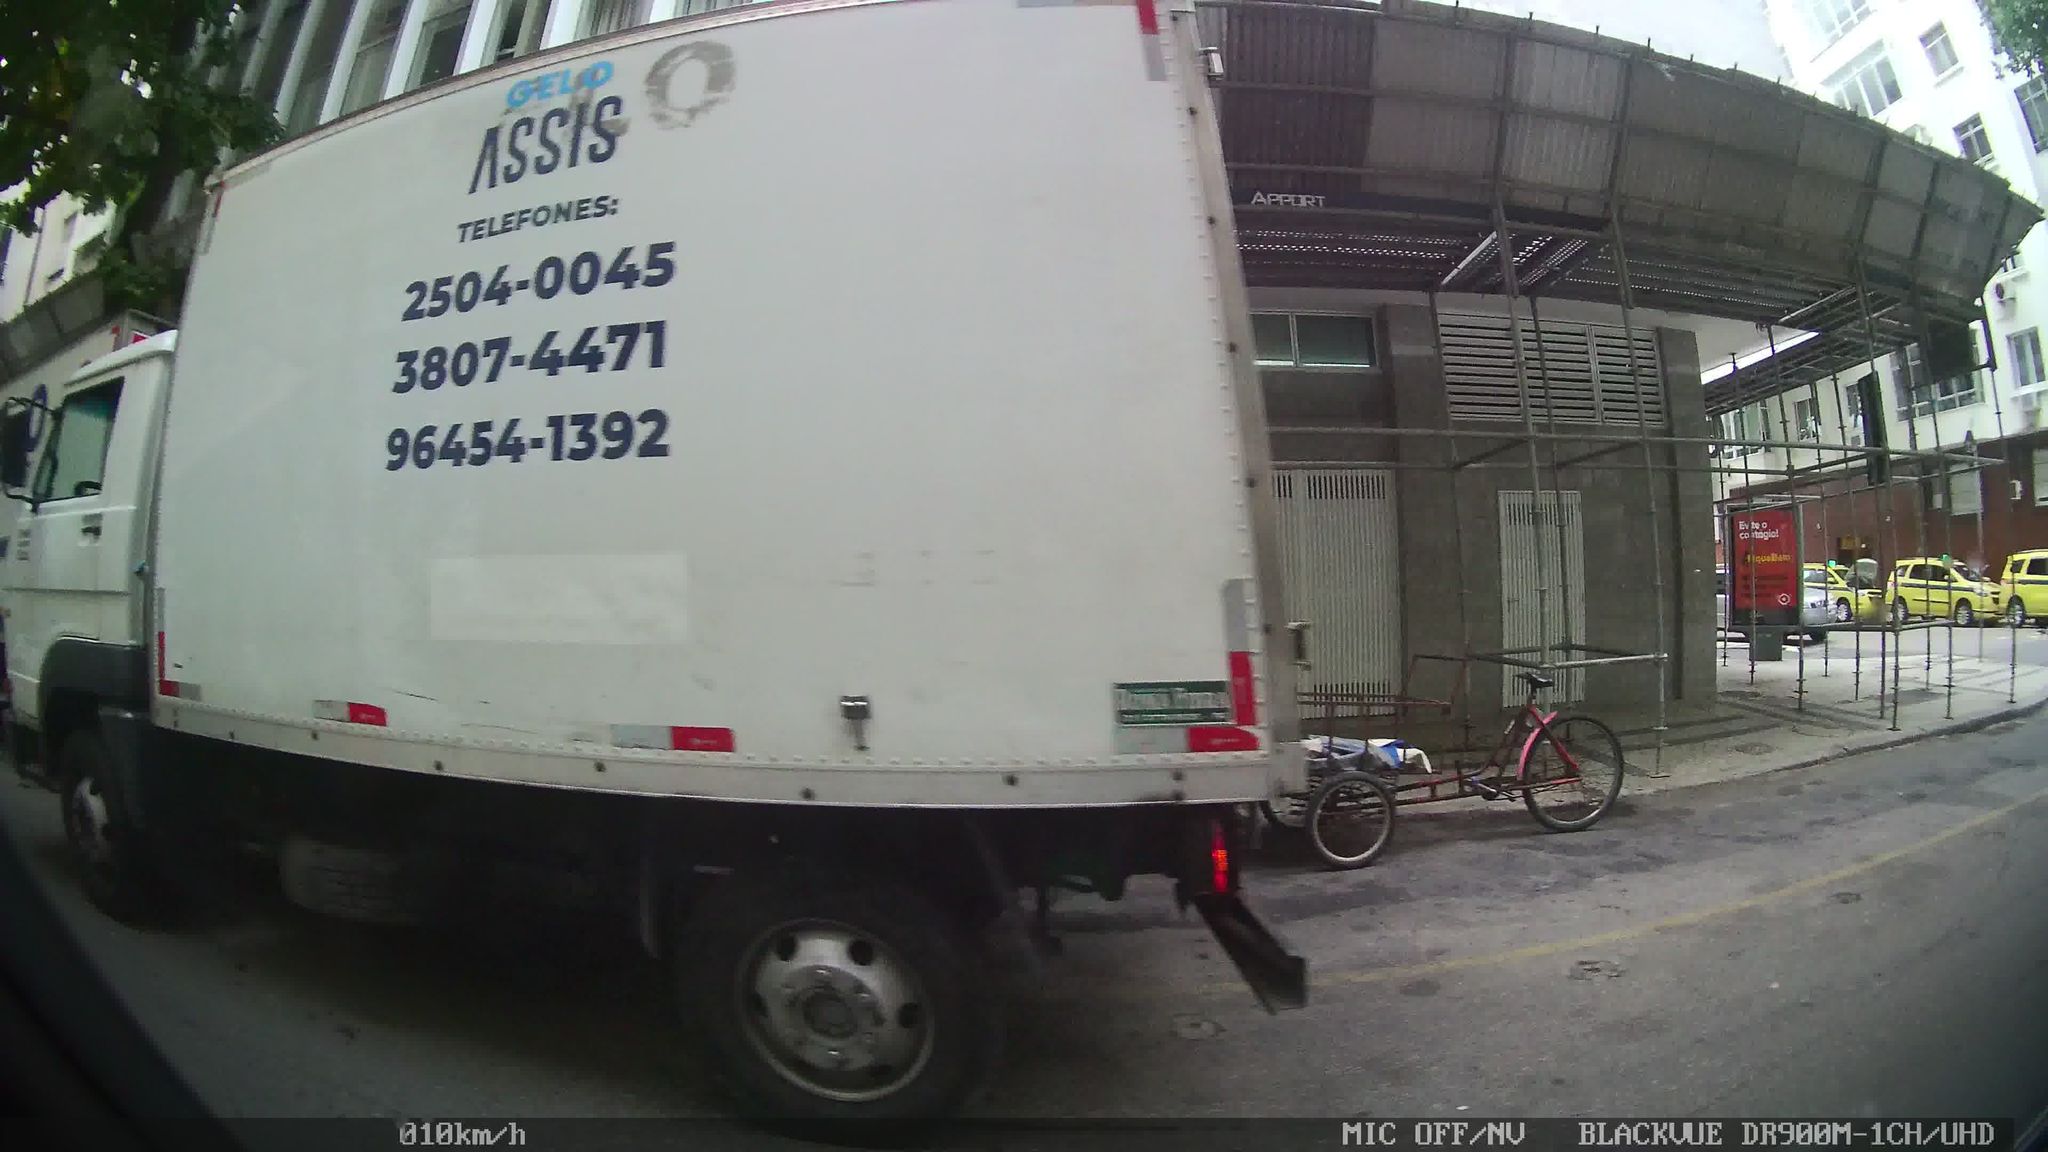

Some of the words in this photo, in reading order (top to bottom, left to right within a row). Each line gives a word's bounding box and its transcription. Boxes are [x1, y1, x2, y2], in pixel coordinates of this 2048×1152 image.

[506, 61, 614, 108] GELO
[468, 96, 623, 194] ASSIS
[457, 196, 619, 243] TELEFONES:
[401, 242, 675, 321] 2504-0045
[392, 320, 666, 394] 3807-4471
[386, 408, 670, 471] 96454-1392
[1739, 521, 1760, 530] Evte
